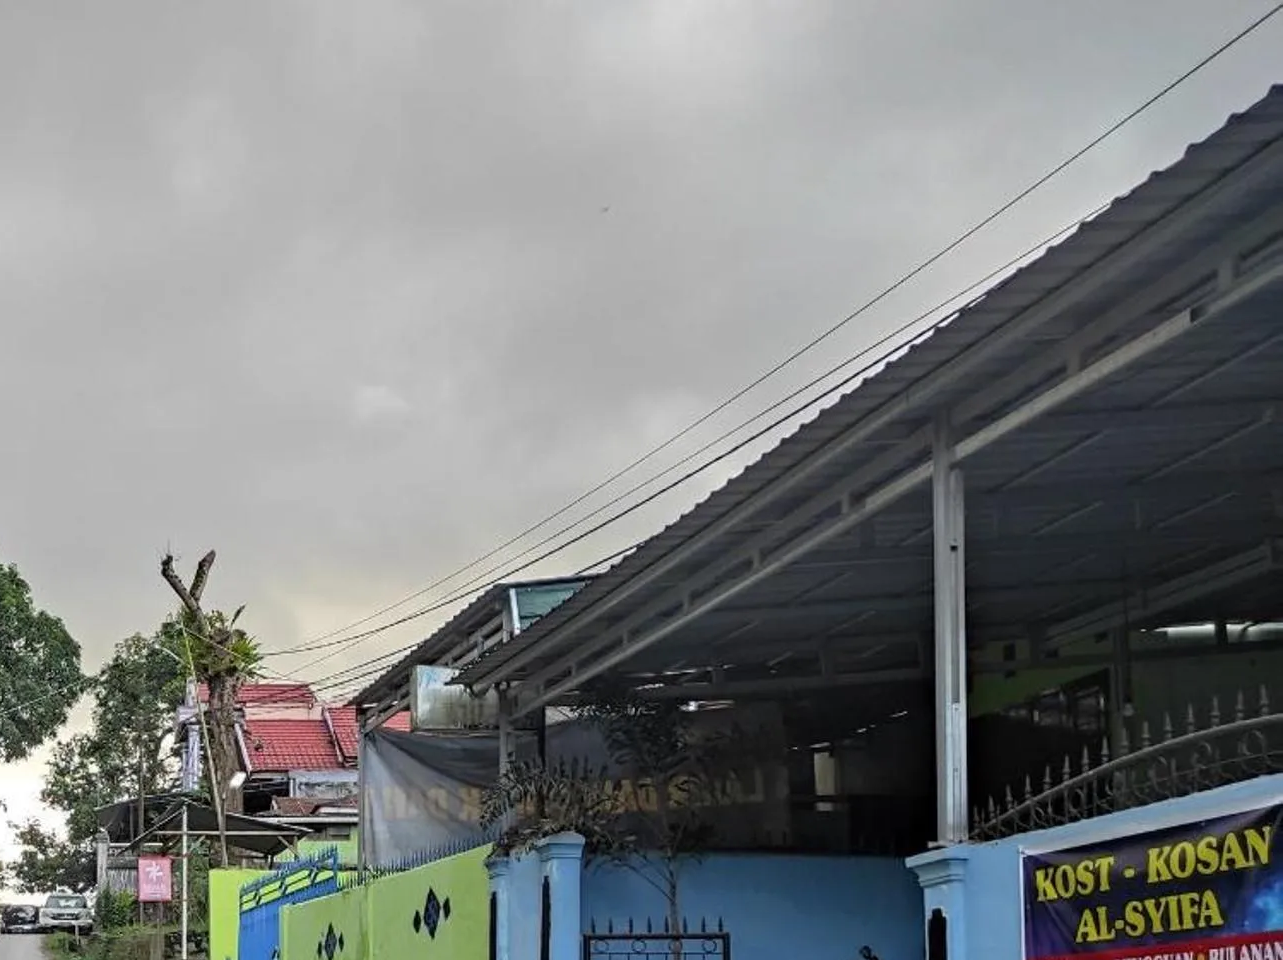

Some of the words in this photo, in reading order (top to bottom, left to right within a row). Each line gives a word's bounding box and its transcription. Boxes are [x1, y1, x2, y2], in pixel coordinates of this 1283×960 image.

[1035, 855, 1115, 903] KOST
[1146, 825, 1273, 885] KOSAN
[1075, 888, 1225, 944] AL-SYIFA
